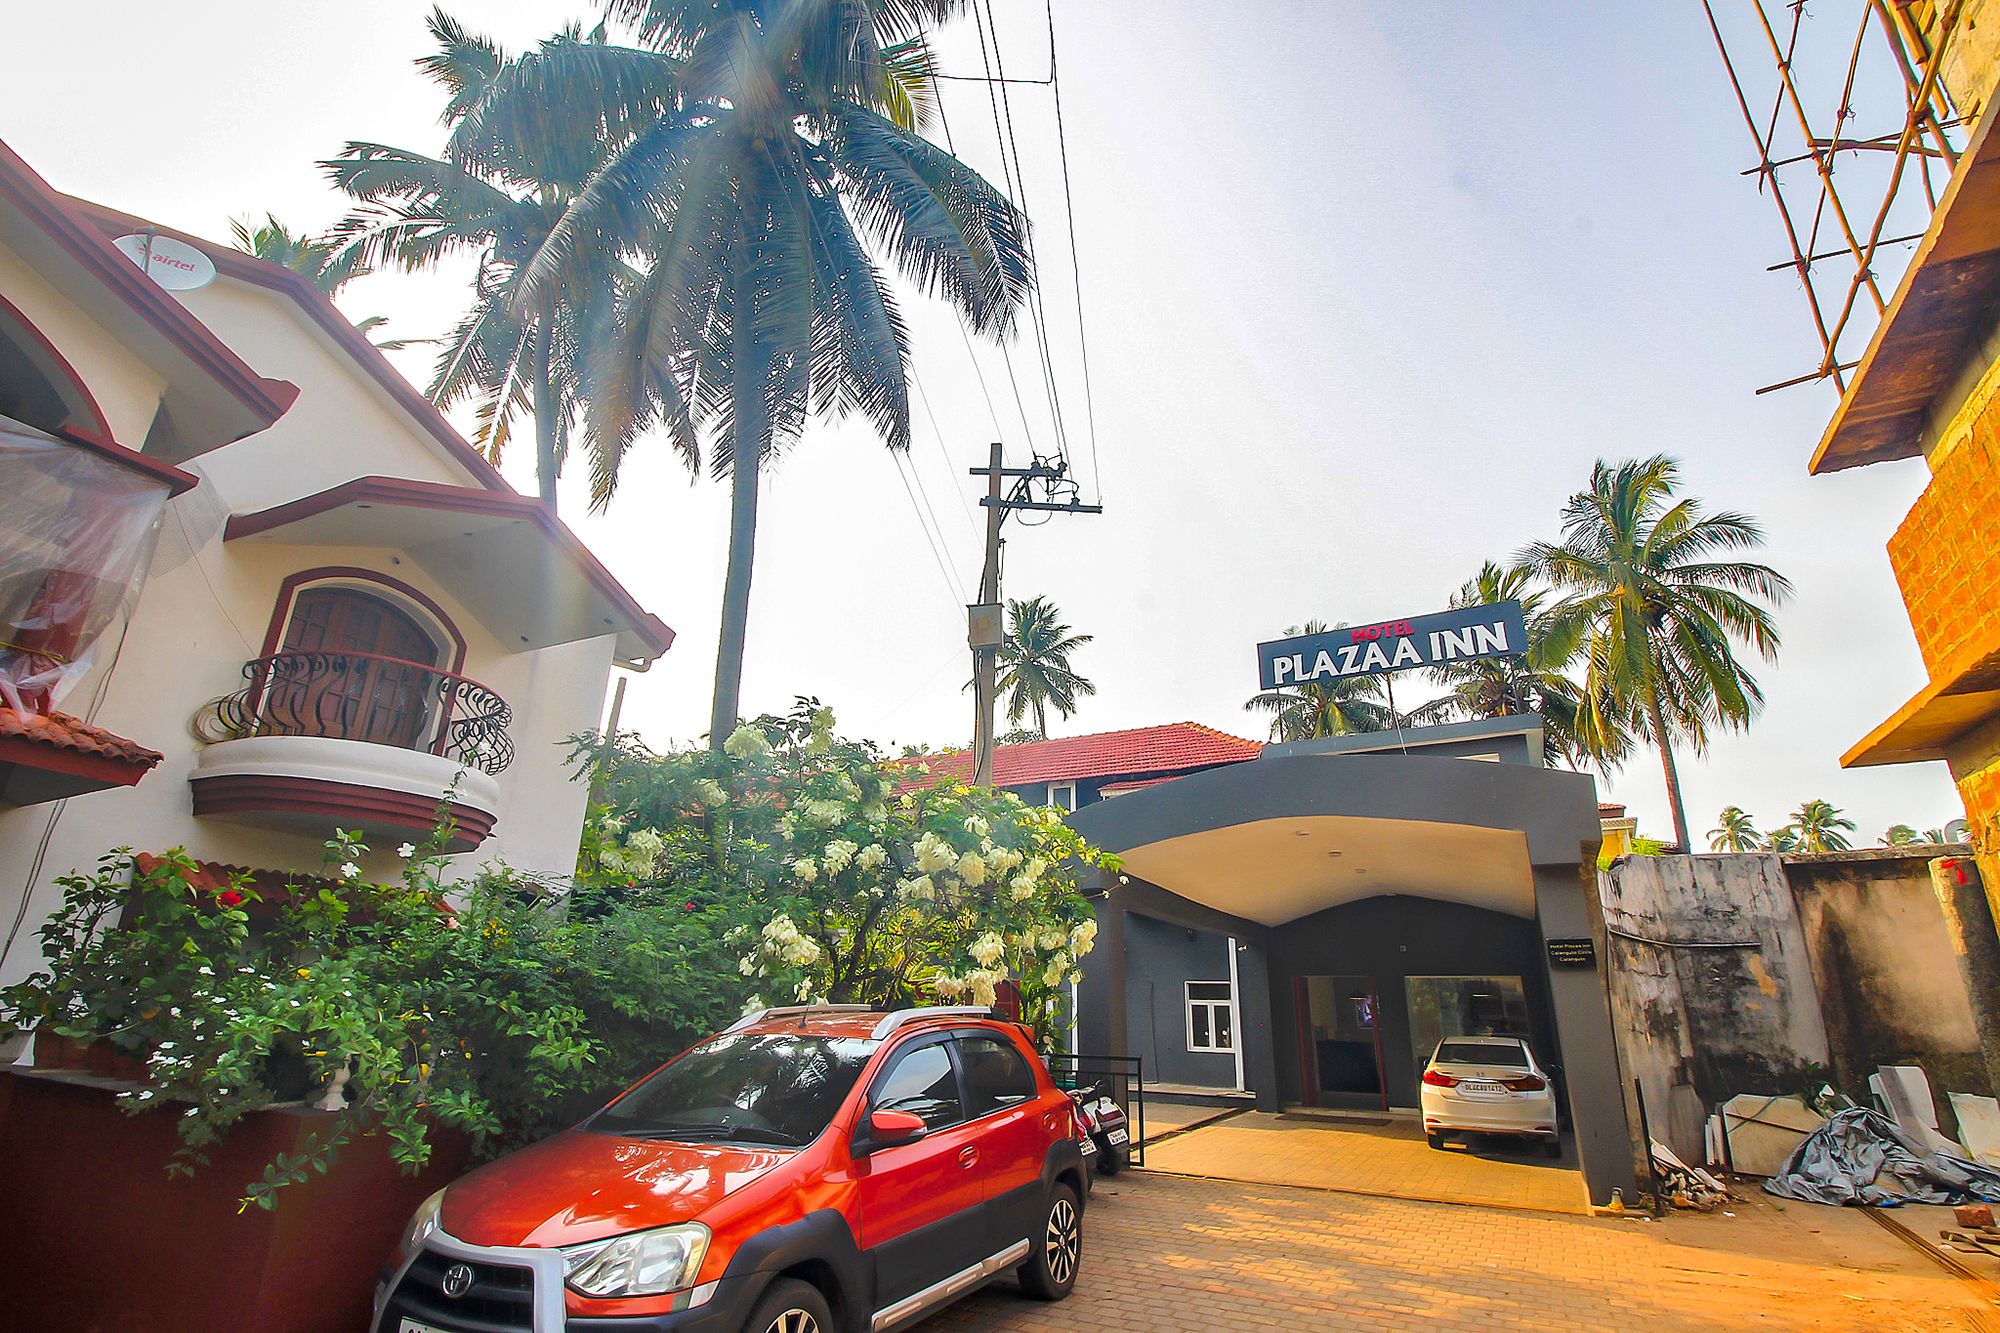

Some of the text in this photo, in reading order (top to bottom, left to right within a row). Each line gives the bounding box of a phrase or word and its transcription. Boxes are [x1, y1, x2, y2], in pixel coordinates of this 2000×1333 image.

[153, 254, 196, 272] airtel
[1351, 620, 1414, 643] HOTEL
[1273, 621, 1510, 685] PLAZAA INN
